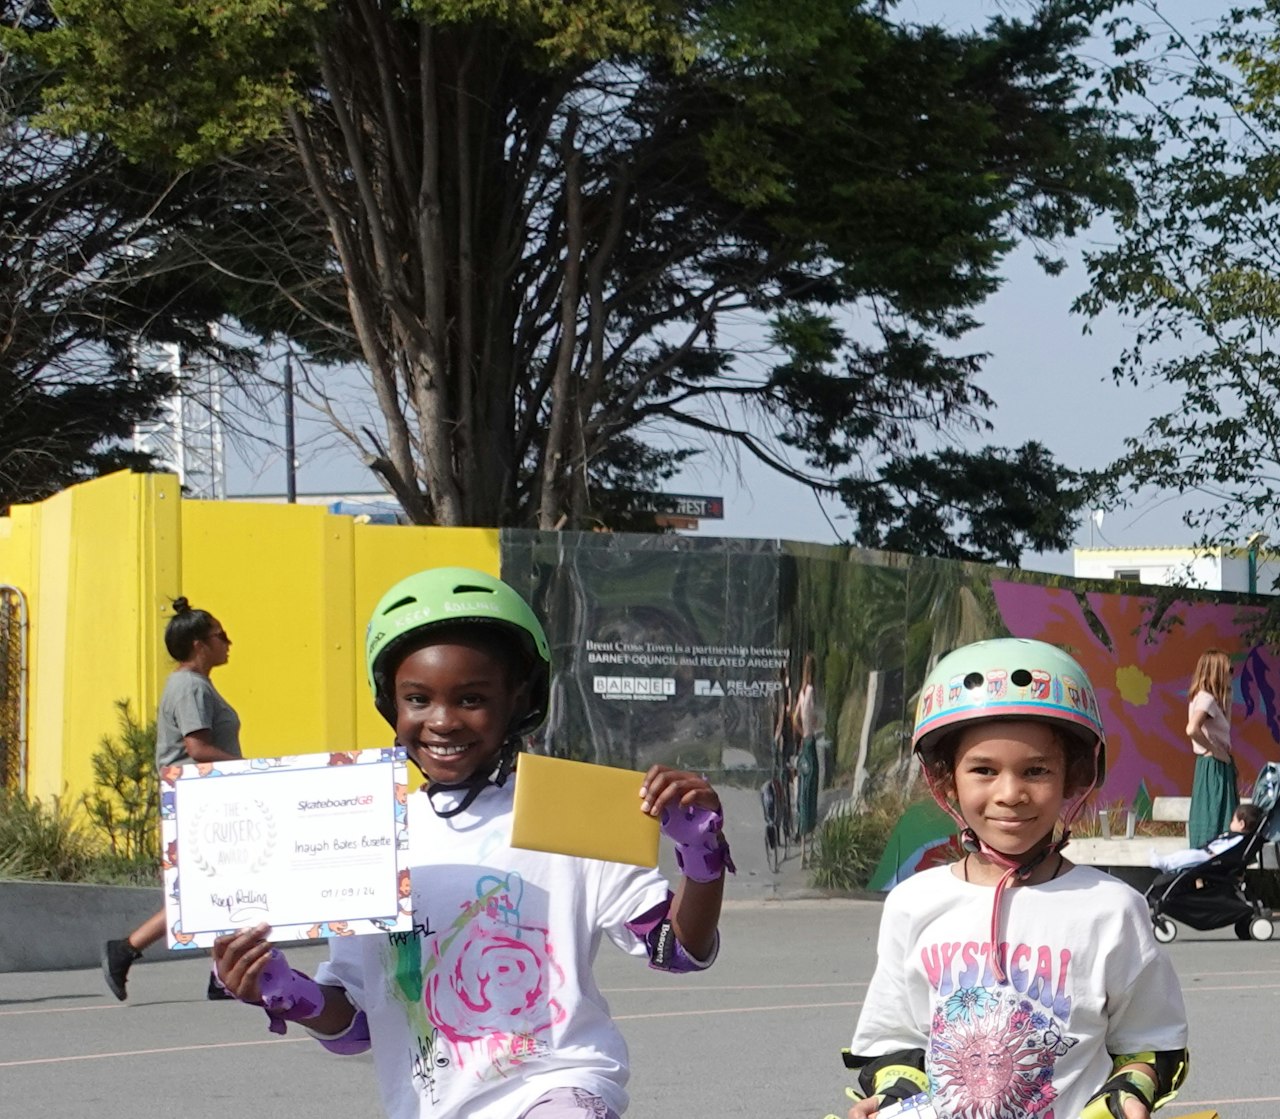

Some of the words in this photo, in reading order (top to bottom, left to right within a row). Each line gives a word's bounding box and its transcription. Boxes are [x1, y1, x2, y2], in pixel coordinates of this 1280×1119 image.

[394, 607, 431, 627] KEEP
[586, 640, 614, 651] Brent
[645, 642, 673, 653] Town
[675, 643, 683, 653] is
[692, 645, 749, 657] partnership
[588, 653, 629, 664] BARNET
[680, 656, 698, 666] and
[700, 657, 746, 668] RELATED
[746, 659, 788, 669] ARGENT
[595, 679, 675, 693] BARNET
[727, 680, 783, 691] RELATED
[727, 688, 775, 698] ARGENT
[297, 795, 374, 812] SkateboardGB
[204, 819, 261, 847] CRUISERS
[294, 839, 330, 856] Inayah
